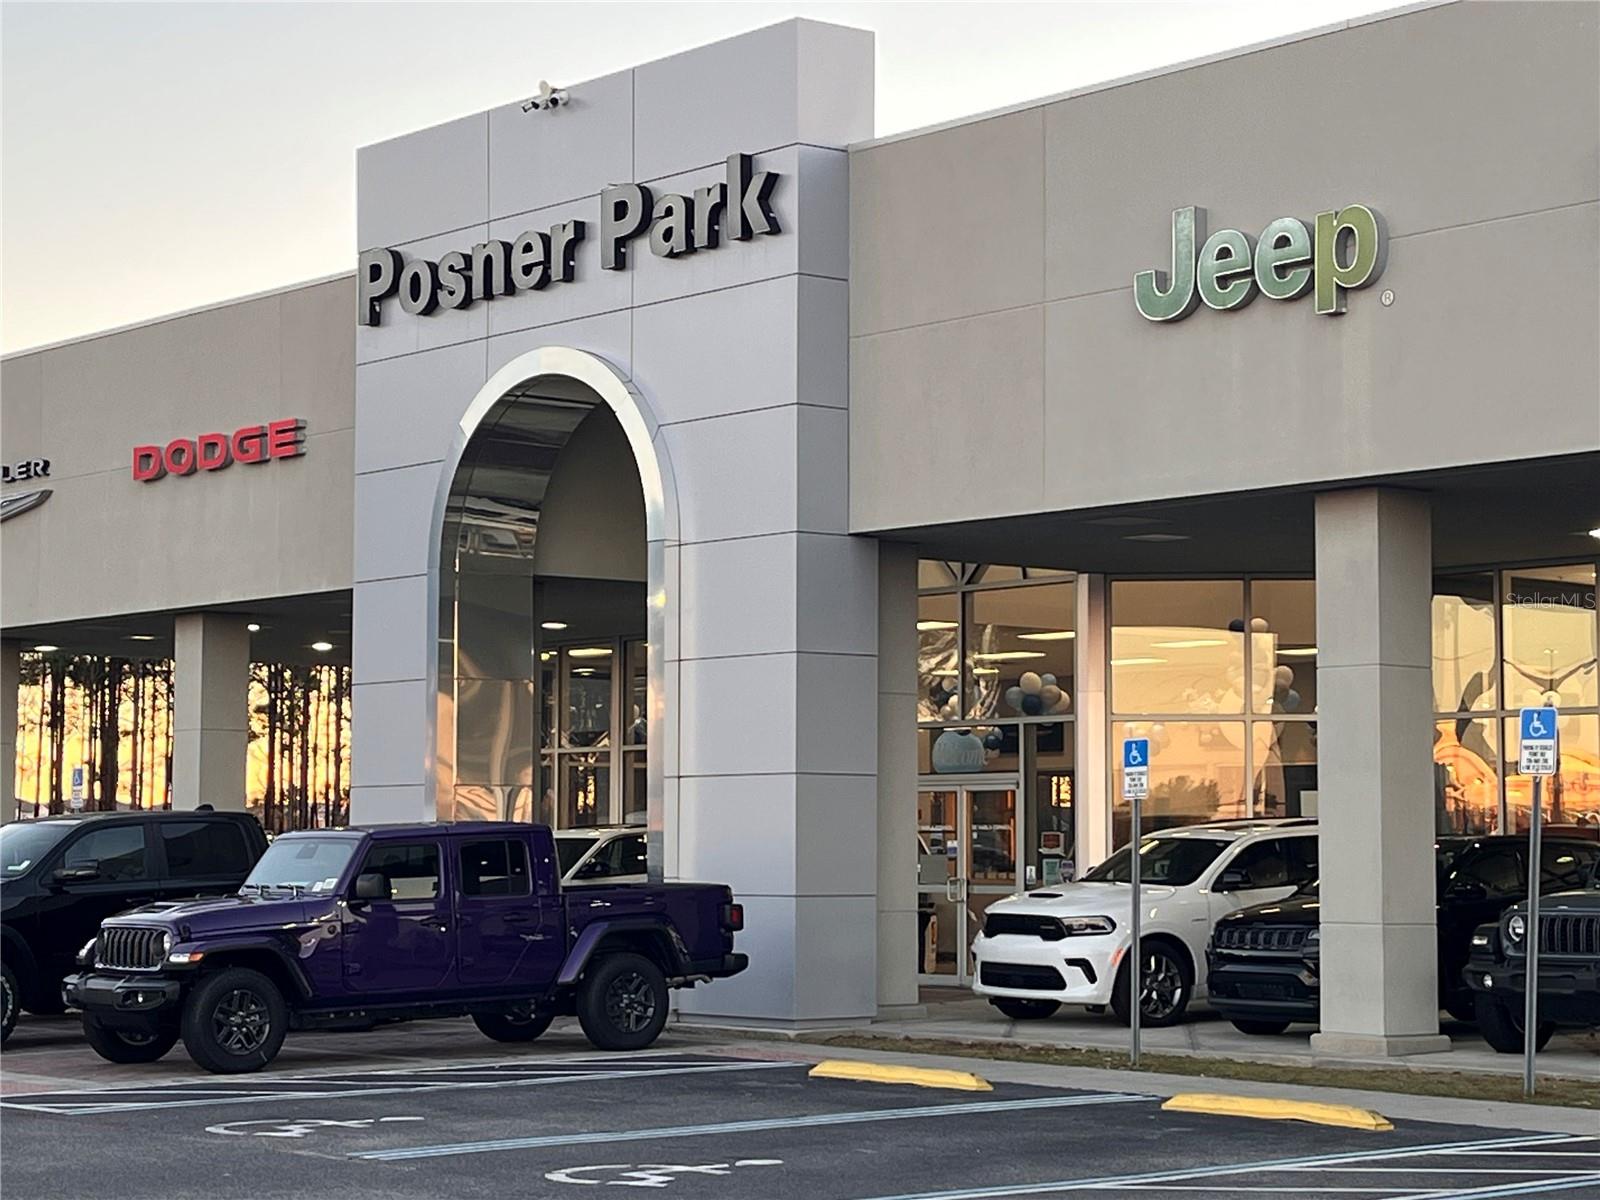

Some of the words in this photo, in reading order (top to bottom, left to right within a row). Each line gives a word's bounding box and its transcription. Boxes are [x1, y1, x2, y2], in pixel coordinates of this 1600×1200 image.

[359, 220, 585, 327] Posner
[600, 152, 782, 270] Park
[1133, 203, 1389, 323] Jeep
[133, 418, 306, 482] DODGE
